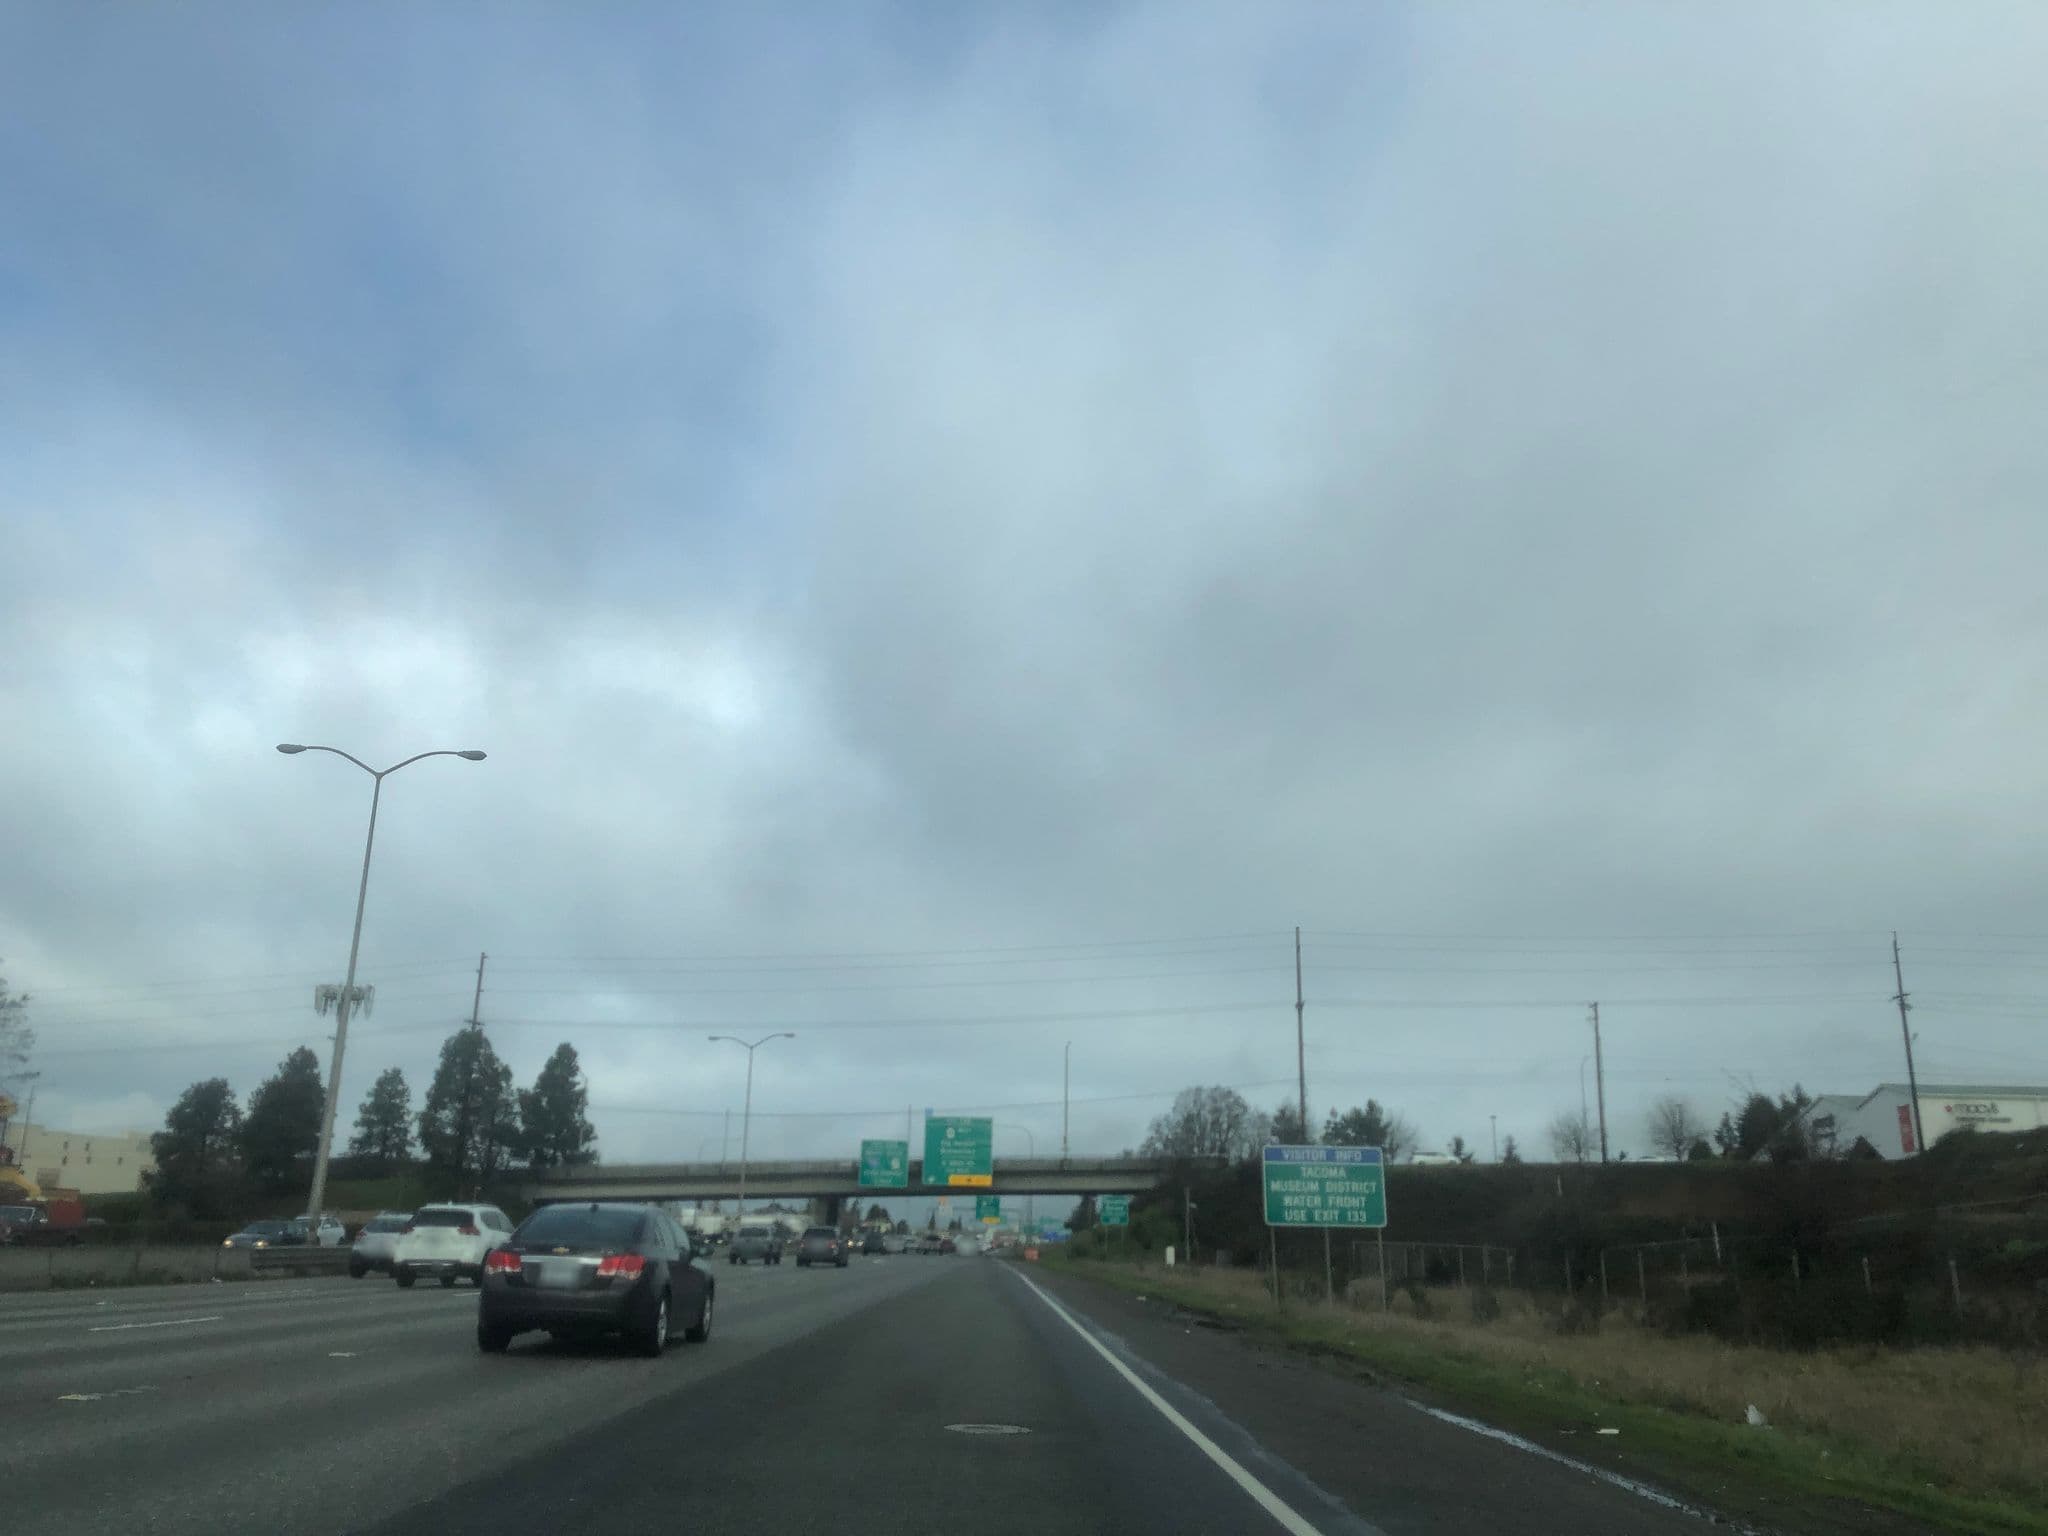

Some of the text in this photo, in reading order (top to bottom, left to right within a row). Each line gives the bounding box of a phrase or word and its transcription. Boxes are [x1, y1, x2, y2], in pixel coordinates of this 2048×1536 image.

[1281, 1149, 1362, 1162] VISITOR INFO
[1301, 1166, 1347, 1178] TACOMA
[1271, 1180, 1377, 1194] MUSEUM DISTRICT
[1283, 1196, 1367, 1209] WATER FRONT
[1284, 1210, 1307, 1222] USE
[1314, 1210, 1340, 1222] EXIT
